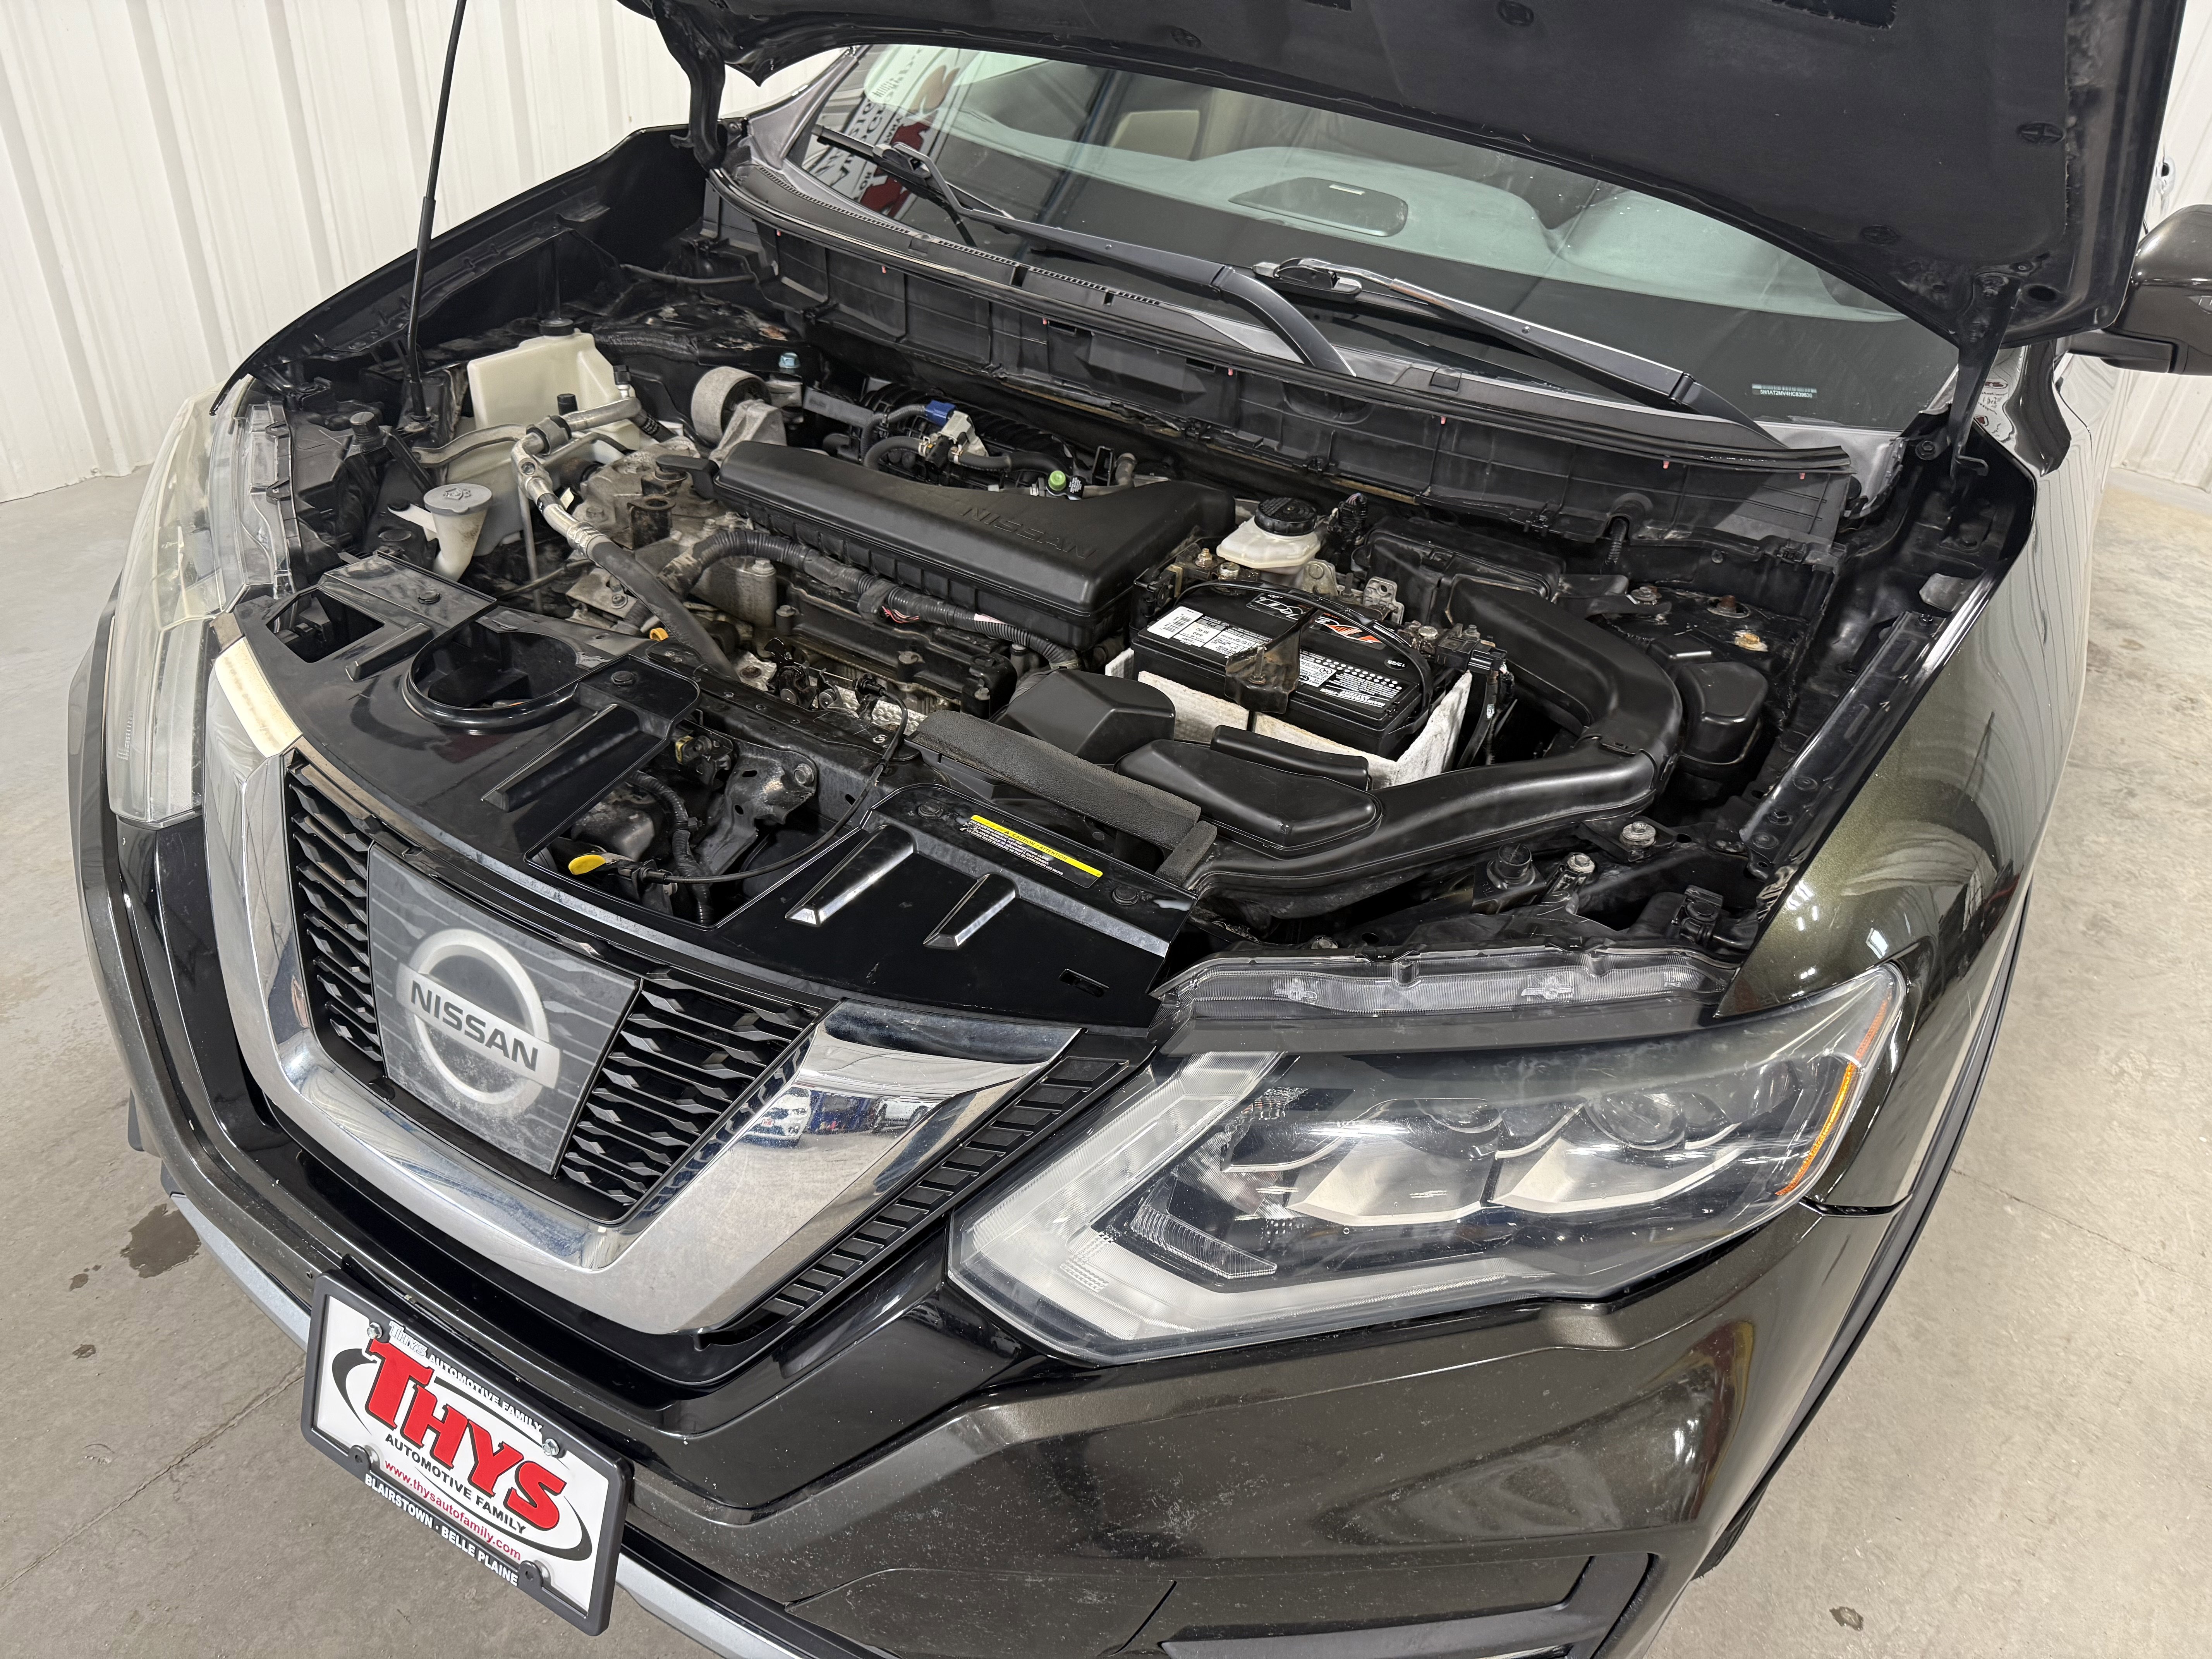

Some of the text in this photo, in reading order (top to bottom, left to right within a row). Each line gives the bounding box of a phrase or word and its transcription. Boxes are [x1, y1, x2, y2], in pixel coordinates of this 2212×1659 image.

[958, 507, 1097, 559] NISSAN
[1012, 834, 1035, 846] CAUTION
[1039, 846, 1068, 860] ATTENTION
[410, 980, 538, 1072] NISSAN
[364, 1338, 568, 1531] THYS
[428, 1353, 500, 1406] AUTOMOTIVE
[501, 1400, 543, 1432] FAMILY
[365, 1474, 518, 1587] BLAIRSTOWN BELLE PLAINE
[384, 1460, 522, 1562] www.thysautofamily.com
[385, 1434, 527, 1535] AUTOMOTIVE FAMILY
